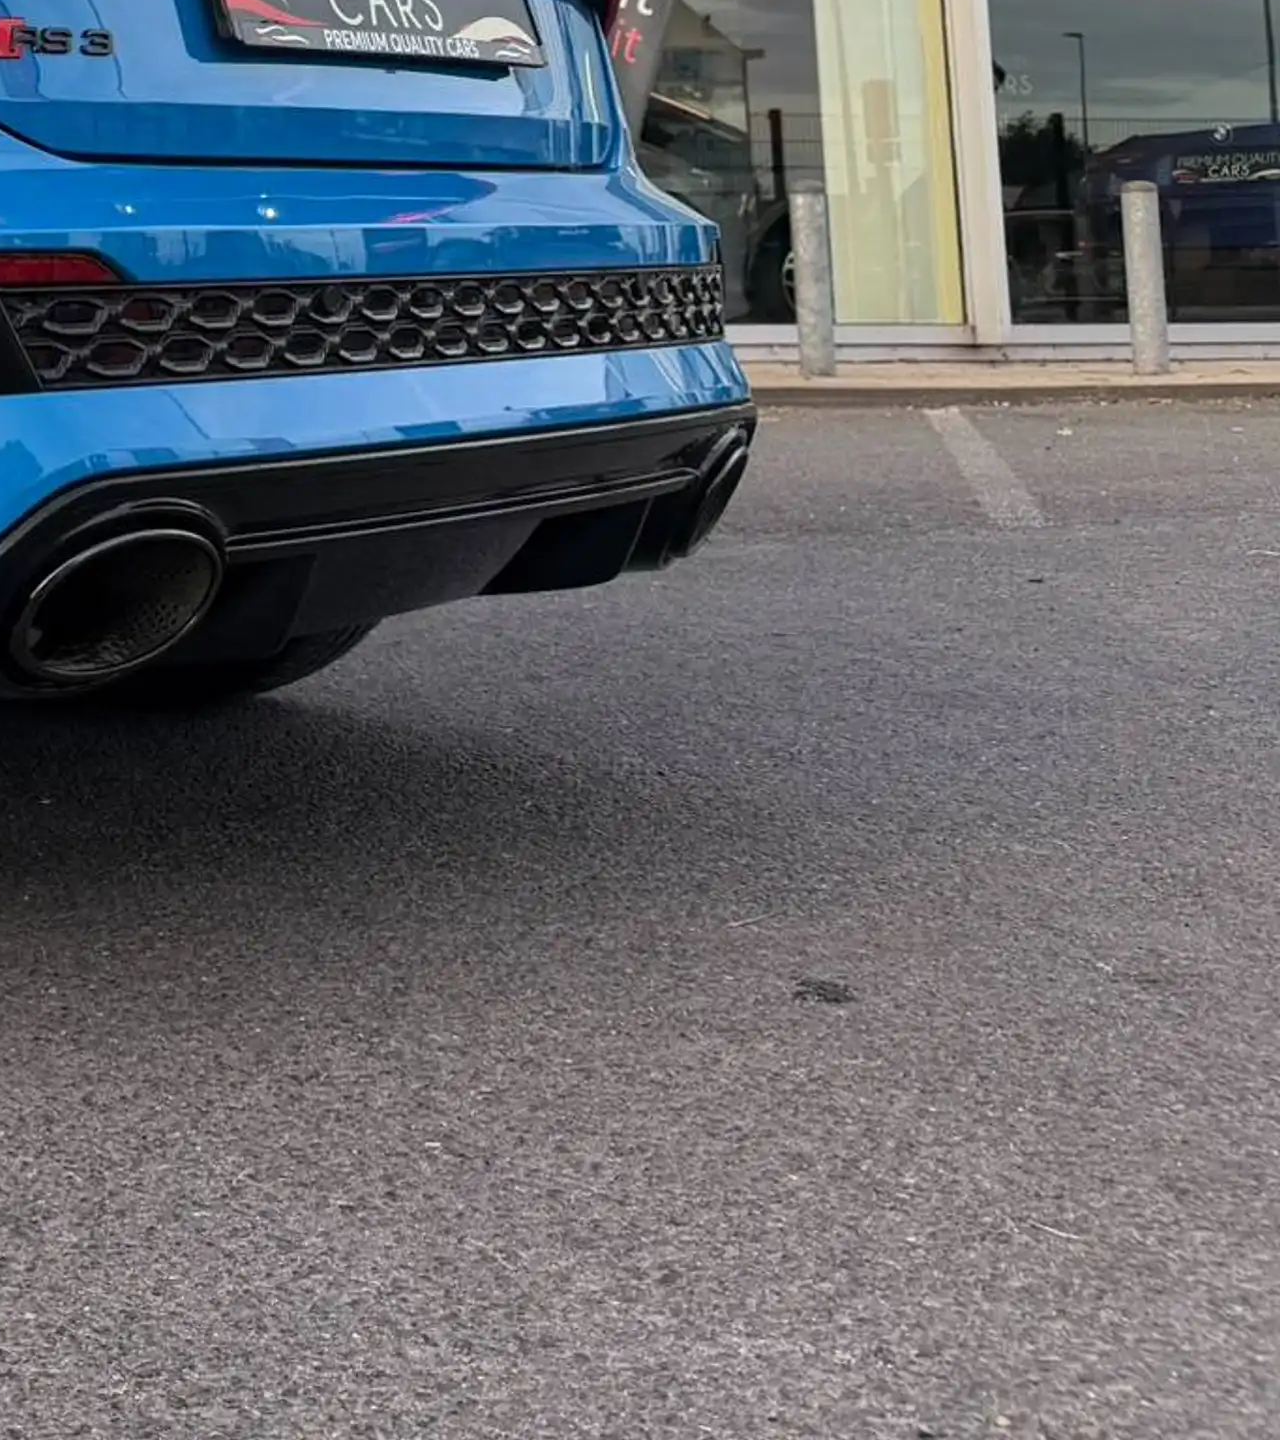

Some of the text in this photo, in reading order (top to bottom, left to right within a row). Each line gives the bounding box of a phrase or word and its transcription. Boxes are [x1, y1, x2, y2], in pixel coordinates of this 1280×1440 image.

[4, 24, 114, 57] RS 3
[323, 28, 481, 58] PREMIUM QUALITY CARS
[612, 20, 643, 63] it
[1208, 164, 1250, 179] CARS
